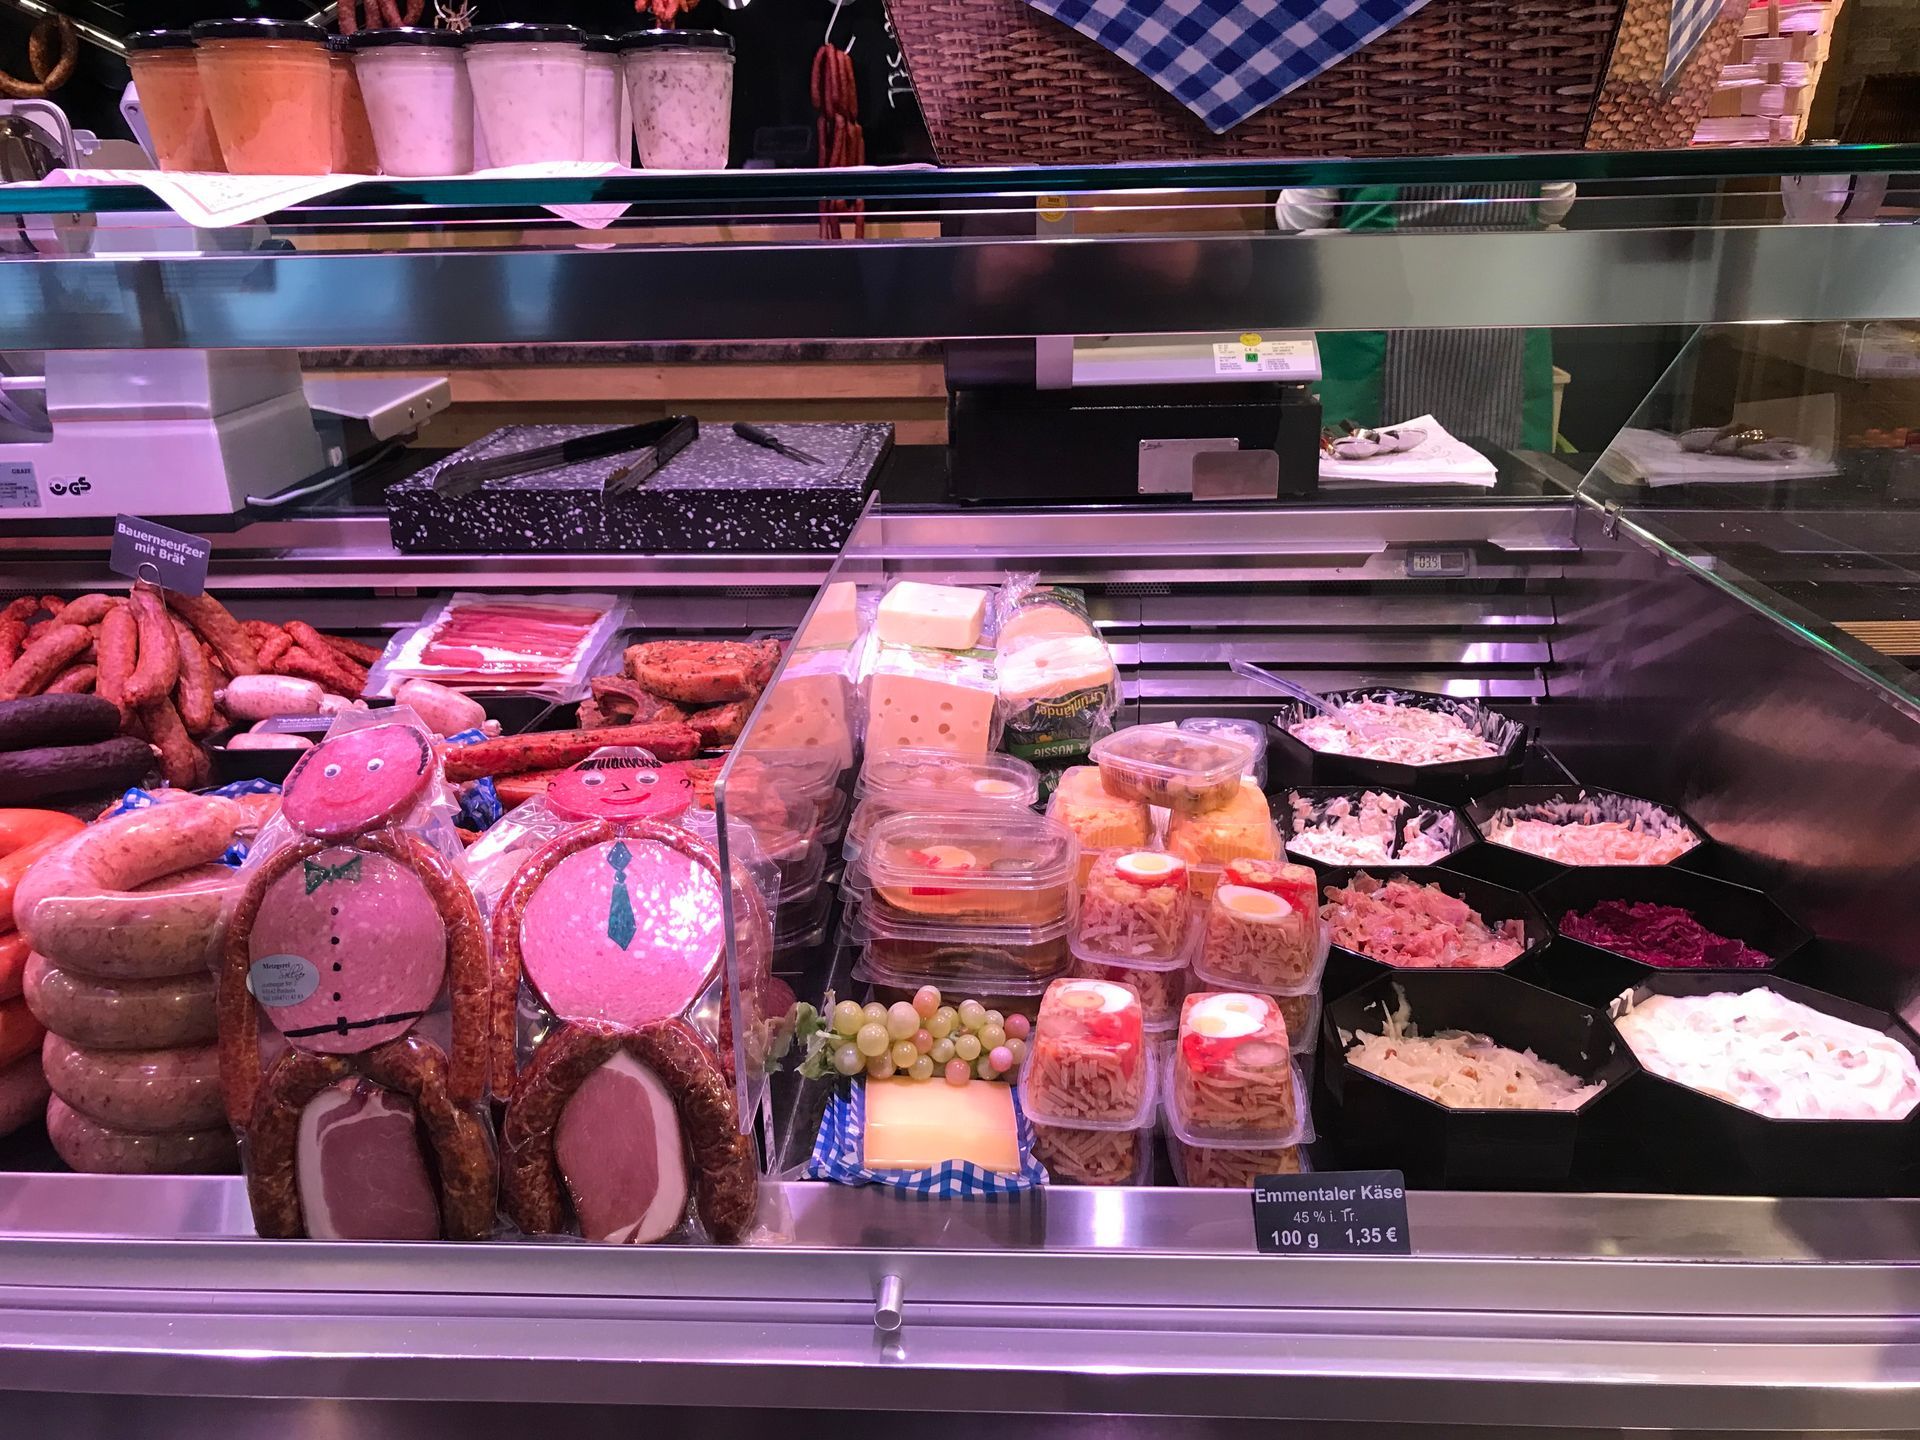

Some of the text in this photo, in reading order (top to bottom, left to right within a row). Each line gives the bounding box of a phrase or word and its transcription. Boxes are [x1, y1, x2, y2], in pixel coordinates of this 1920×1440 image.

[117, 523, 205, 559] Bauernseufzer
[134, 542, 187, 566] mit Brät
[1035, 691, 1106, 718] Grünländer
[1034, 744, 1074, 758] NUSSIG
[1255, 1184, 1403, 1203] Emmentaler Käse
[1293, 1208, 1359, 1224] 45 % i. Tr.
[1271, 1227, 1398, 1249] 100 g 1,35 €
